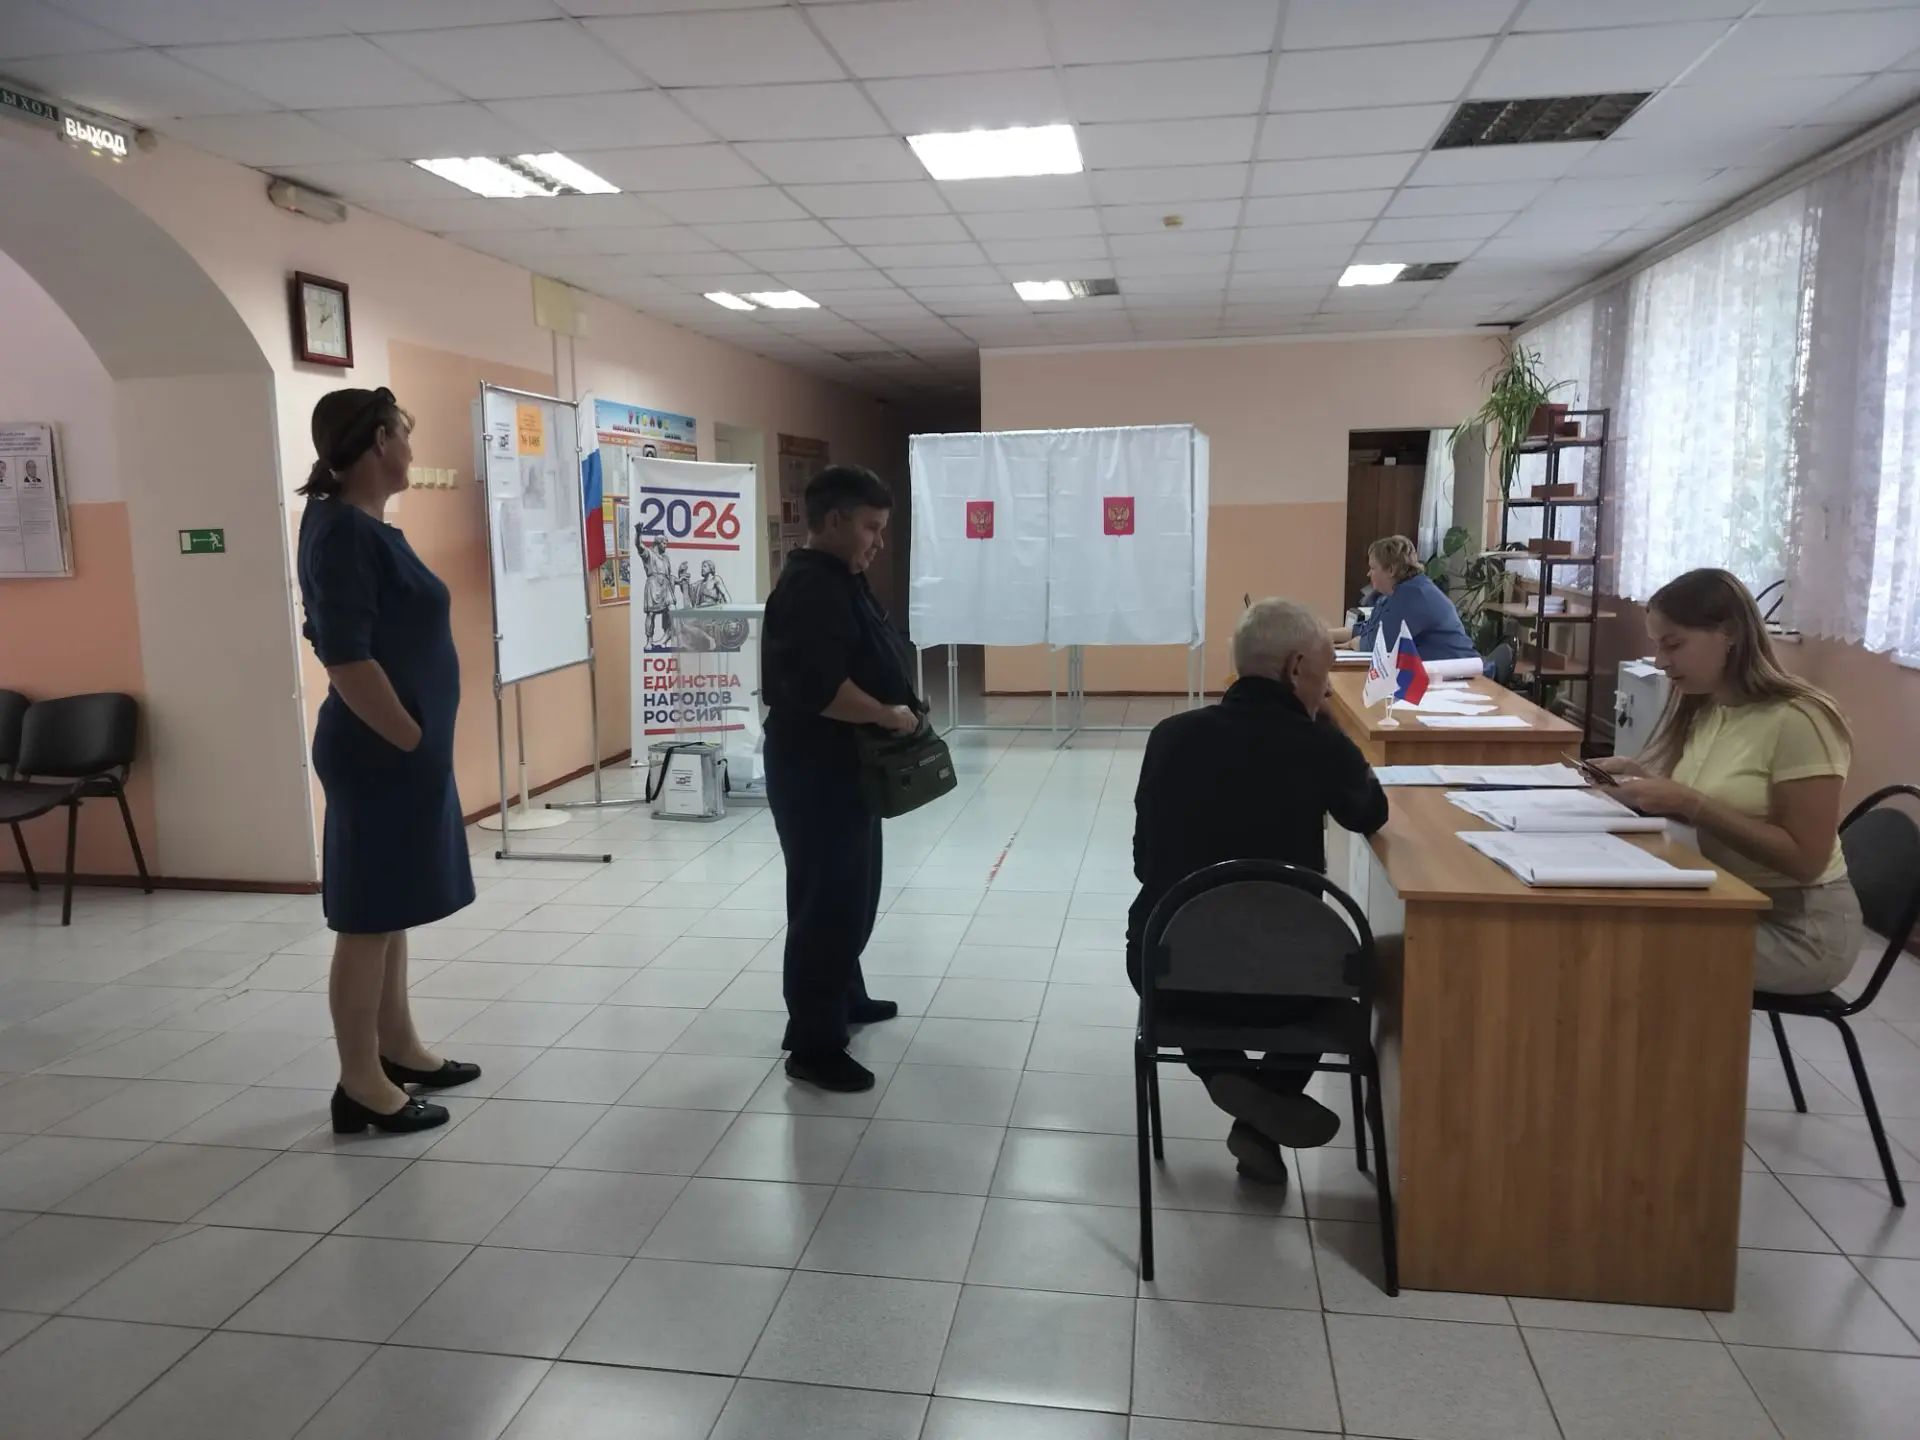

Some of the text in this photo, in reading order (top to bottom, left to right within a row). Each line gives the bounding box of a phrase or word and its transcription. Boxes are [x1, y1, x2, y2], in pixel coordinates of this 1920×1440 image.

[65, 117, 127, 155] ВЫХОД
[640, 497, 740, 540] 2026
[643, 658, 680, 673] ГОД
[643, 674, 741, 691] ЕДИНСТВА
[643, 691, 732, 708] НАРОДОВ
[643, 706, 722, 724] РОССИИ
